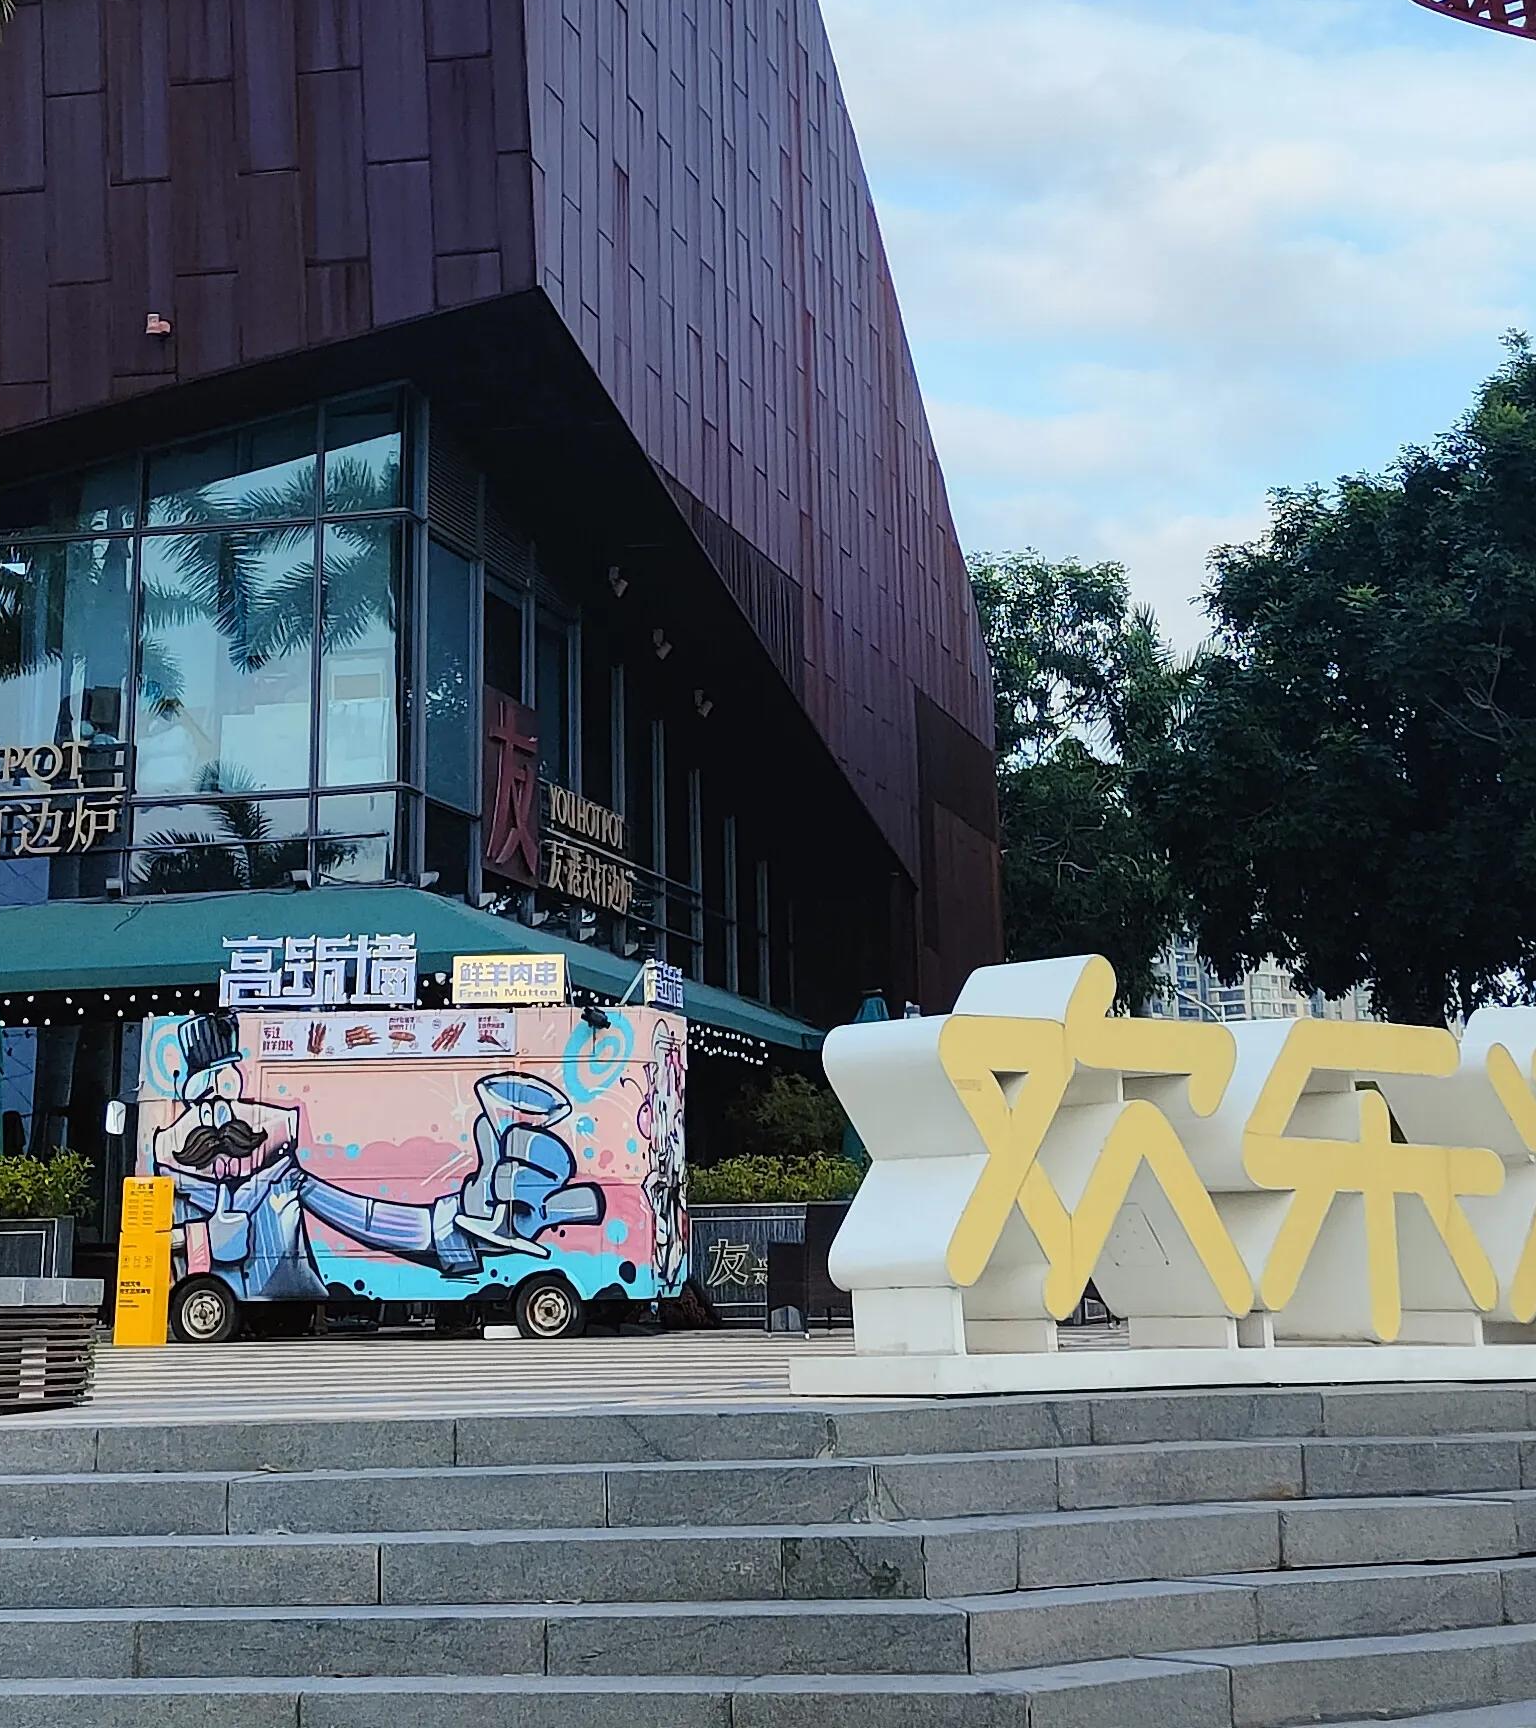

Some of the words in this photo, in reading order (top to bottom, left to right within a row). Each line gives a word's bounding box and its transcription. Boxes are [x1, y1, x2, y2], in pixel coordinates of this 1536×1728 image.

[1, 741, 90, 783] POT
[486, 700, 537, 880] 友
[549, 783, 577, 829] YOU
[459, 988, 498, 999] Fresh
[504, 988, 557, 998] Mutton
[460, 962, 558, 987] 鲜羊肉串
[706, 1238, 750, 1287] 友
